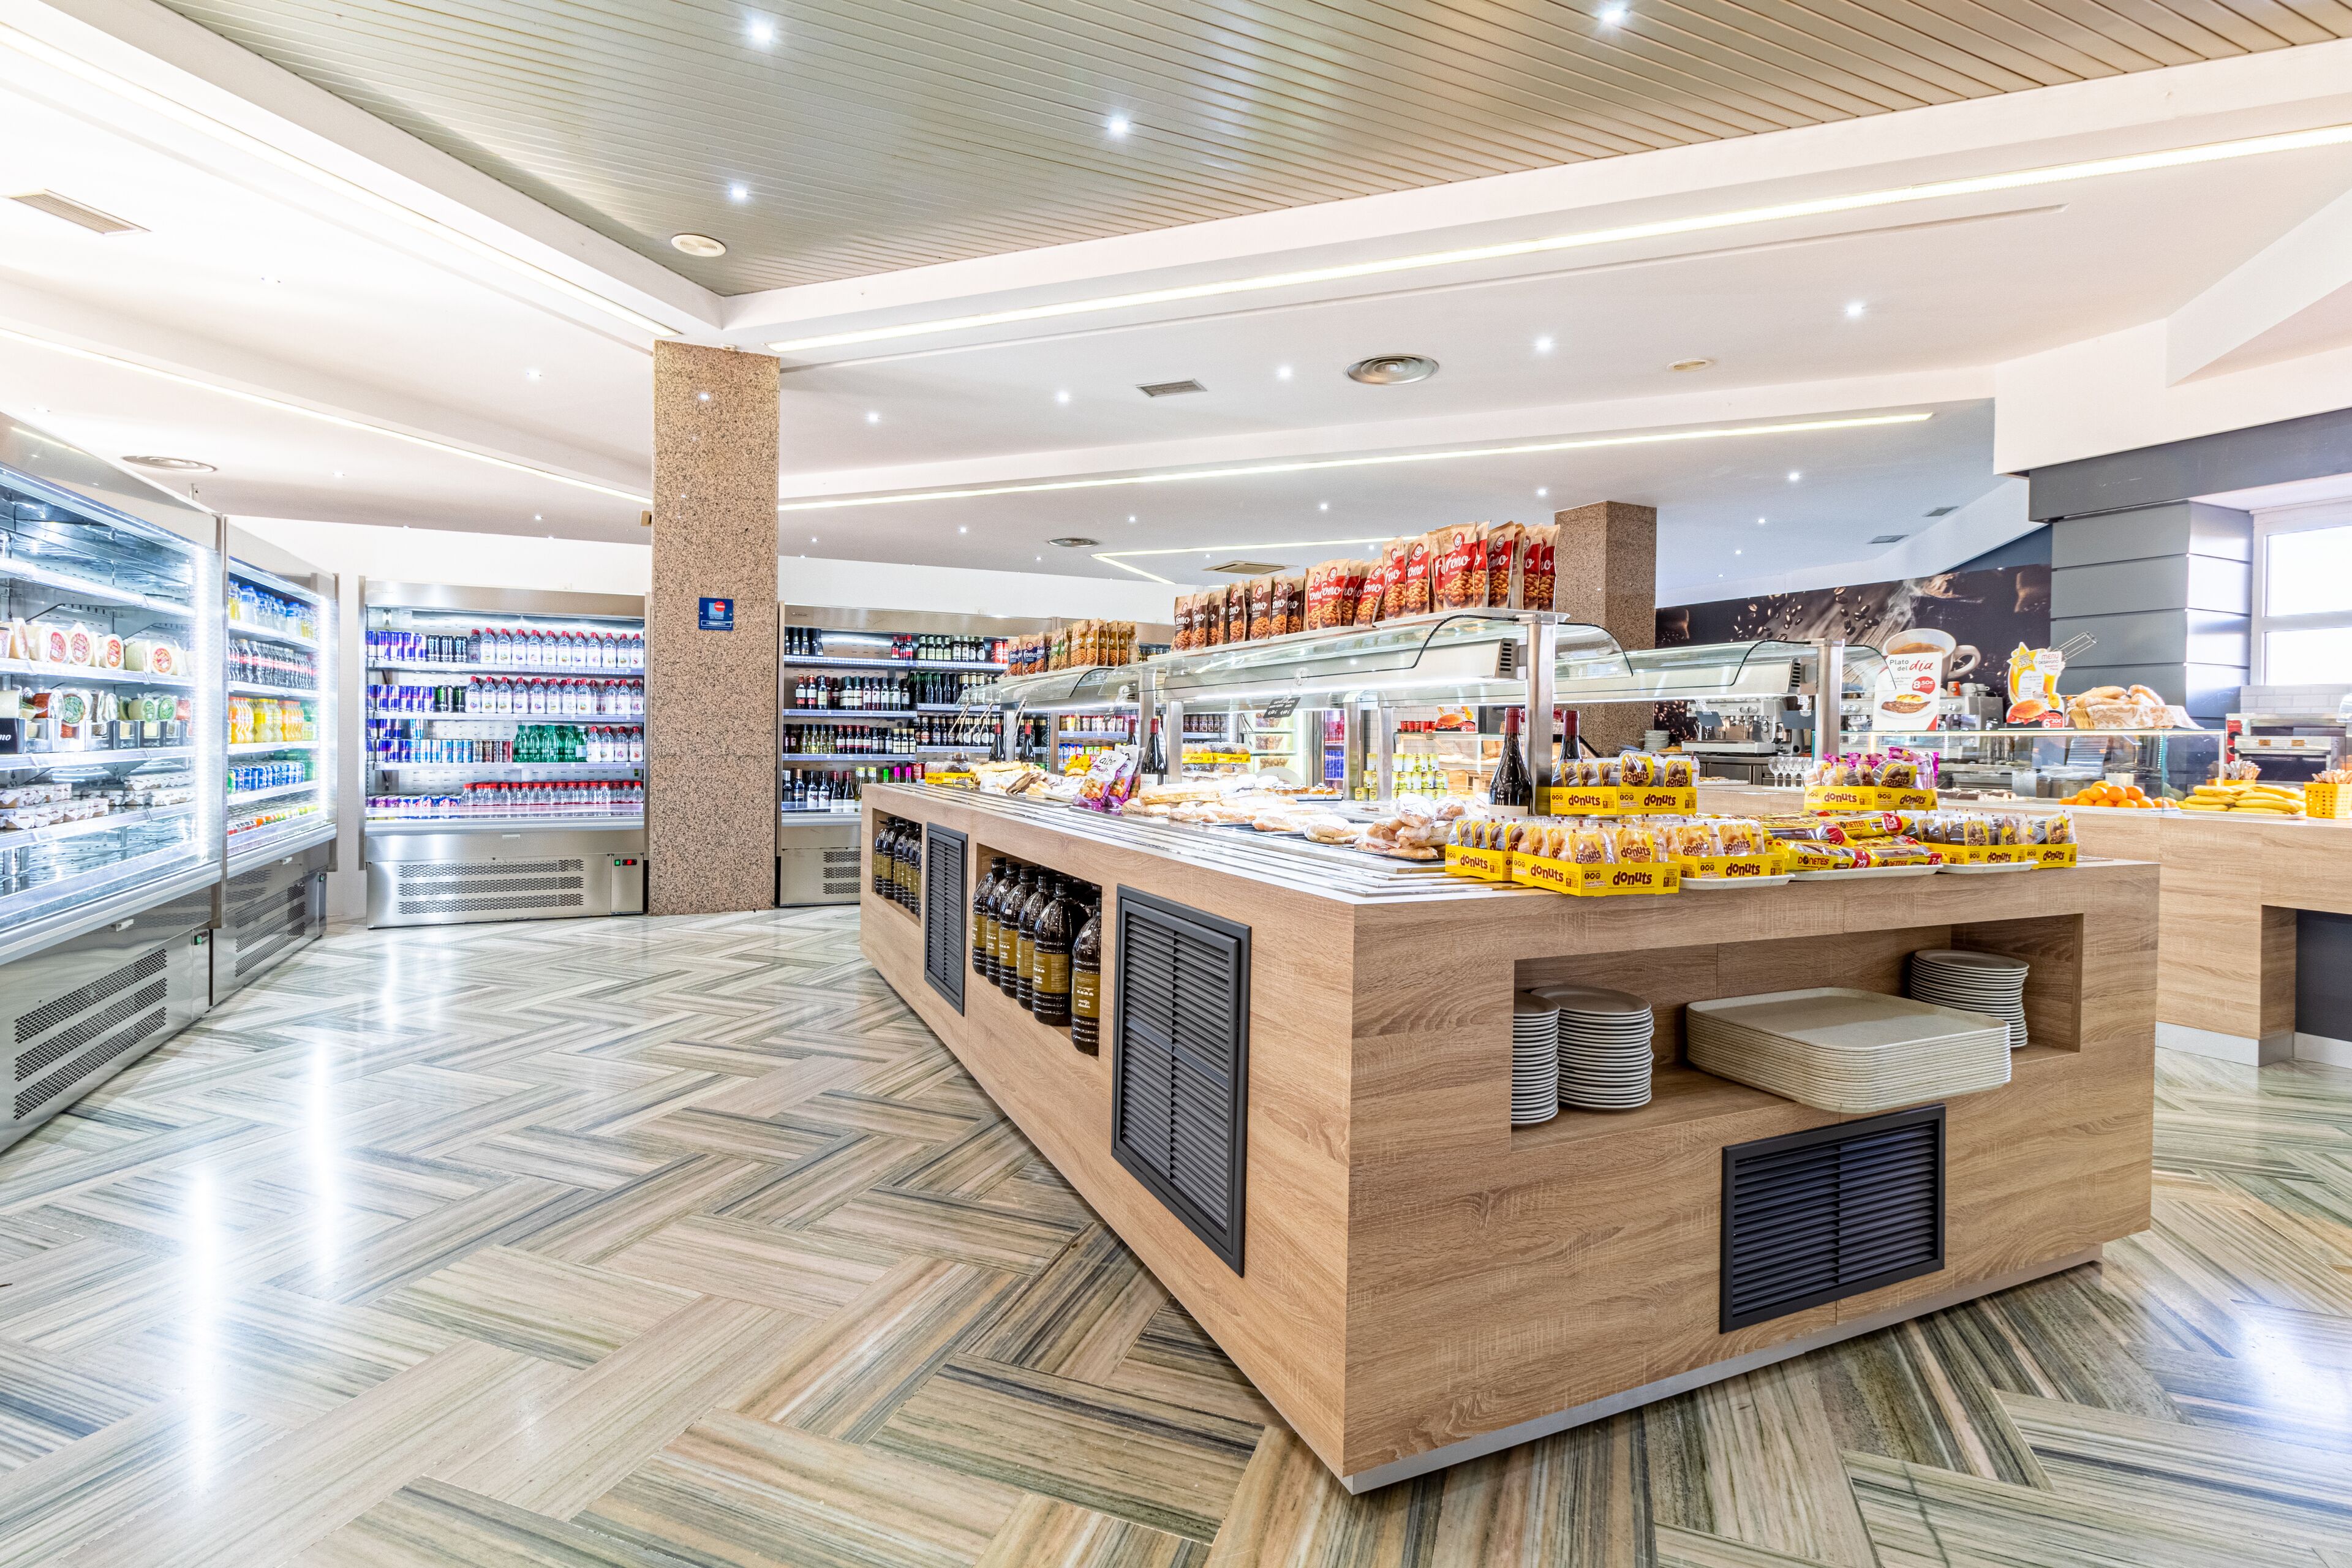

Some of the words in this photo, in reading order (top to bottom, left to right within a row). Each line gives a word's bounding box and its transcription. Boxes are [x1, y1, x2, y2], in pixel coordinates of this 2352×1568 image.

[1623, 772, 1649, 783] donuts
[1665, 775, 1689, 787] donuts
[1881, 777, 1910, 787] donuts
[1569, 794, 1600, 807] donuts
[1644, 794, 1676, 807] donuts
[1825, 792, 1857, 803] donuts
[1899, 794, 1927, 804] donuts
[1621, 846, 1651, 858] donuts
[1683, 842, 1709, 856] donuts
[1724, 840, 1751, 854] donuts
[1460, 854, 1488, 870] donuts
[1575, 850, 1602, 864] donuts
[1987, 852, 2011, 862] donuts
[2043, 850, 2065, 861] donuts
[1531, 864, 1564, 883] donuts
[1726, 862, 1760, 877] donuts
[1613, 871, 1653, 886] donuts
